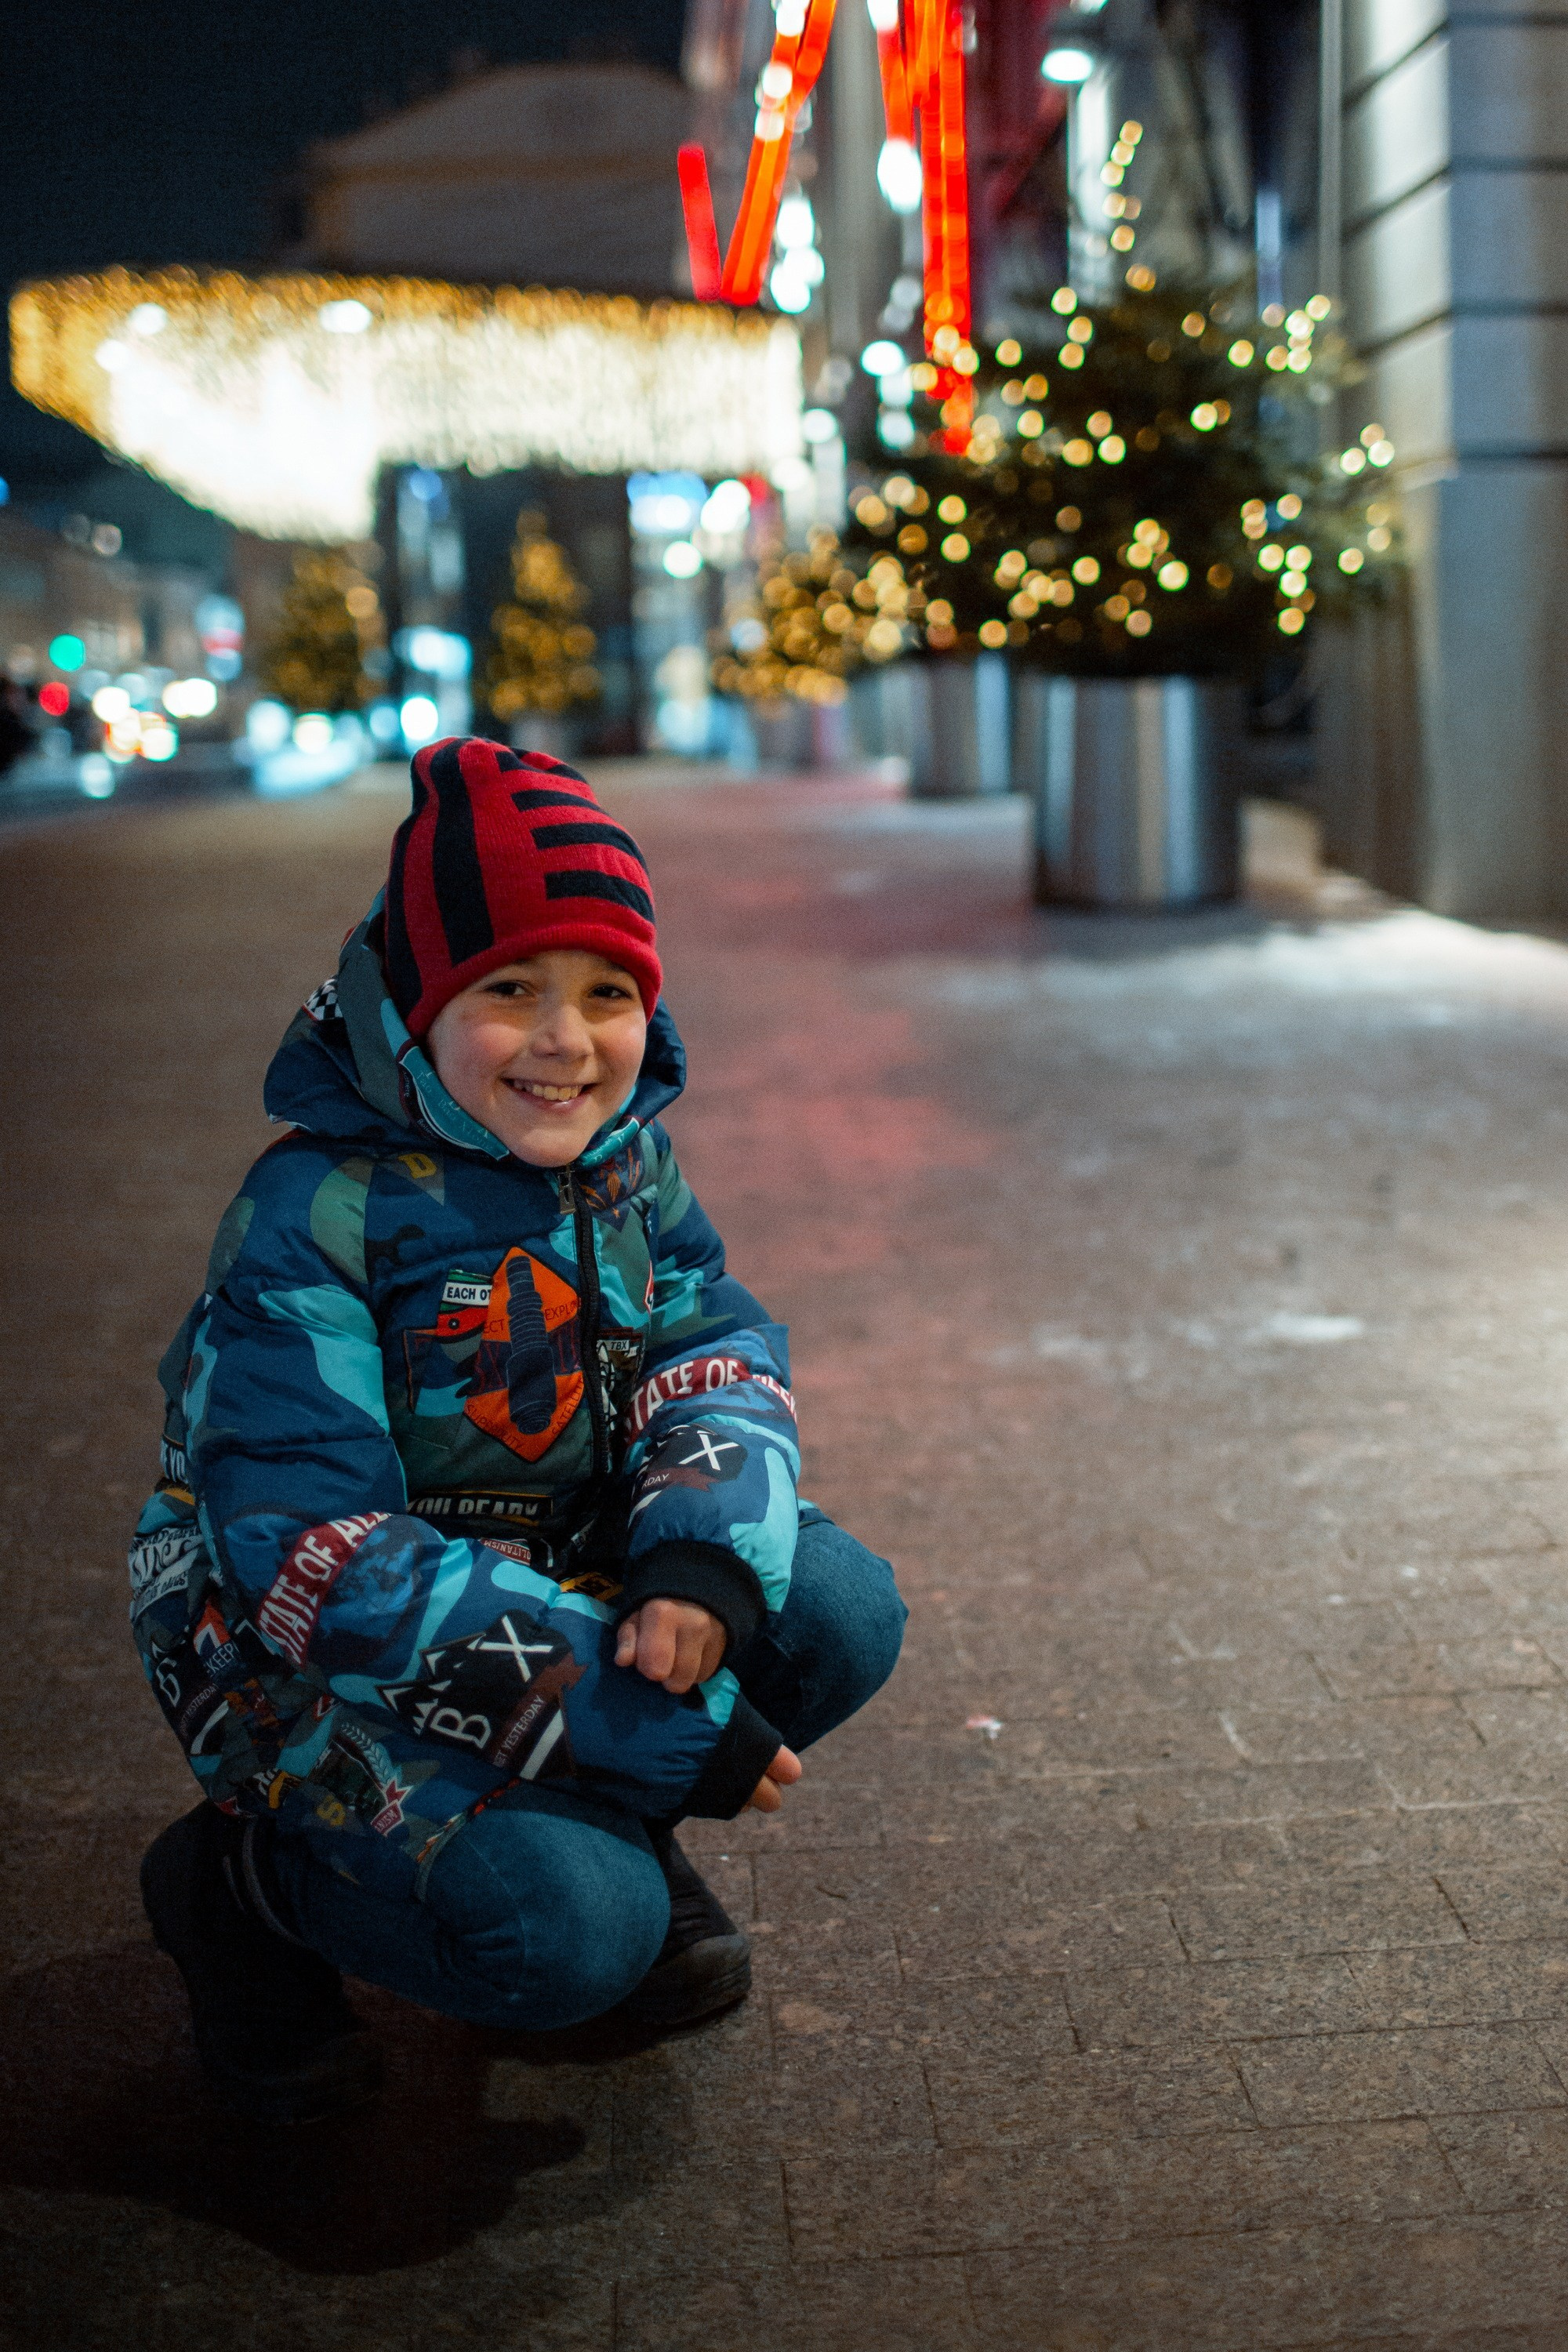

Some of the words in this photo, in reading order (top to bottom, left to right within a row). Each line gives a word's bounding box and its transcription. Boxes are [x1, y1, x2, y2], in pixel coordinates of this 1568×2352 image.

[446, 1286, 476, 1301] EACH
[611, 1341, 627, 1350] TBX
[293, 1534, 339, 1581] OF
[502, 1694, 546, 1752] YESTERDAY
